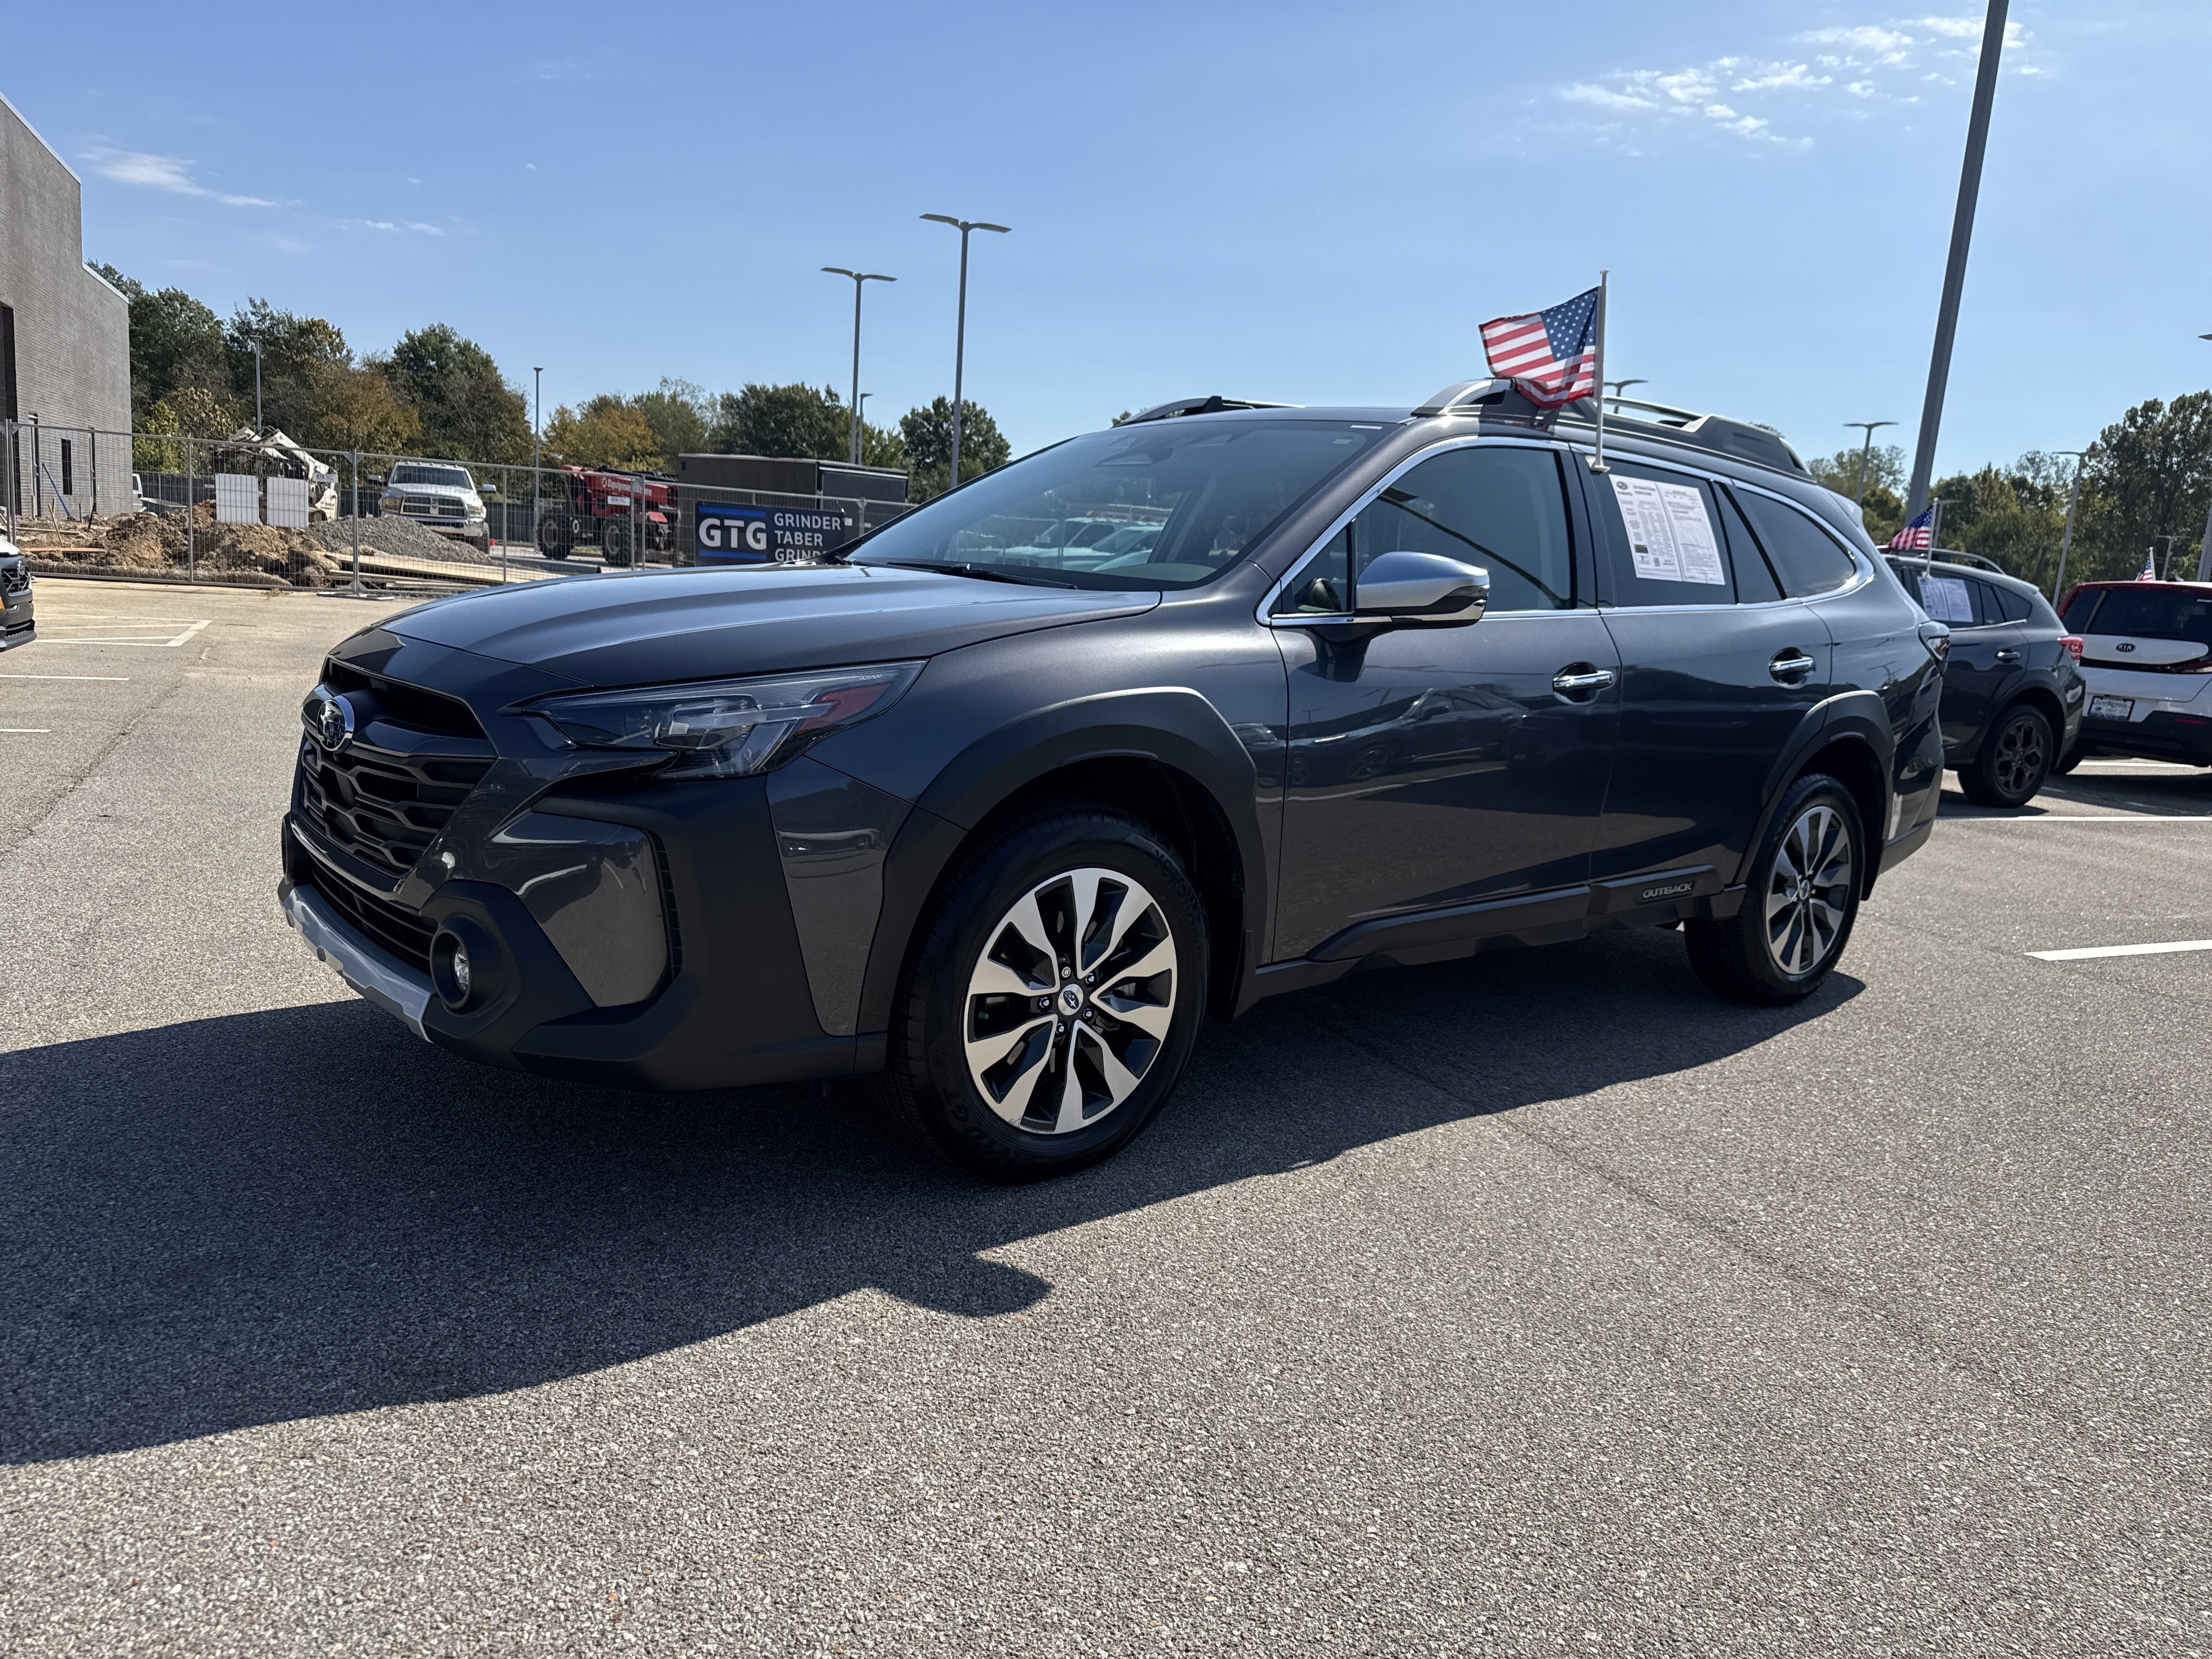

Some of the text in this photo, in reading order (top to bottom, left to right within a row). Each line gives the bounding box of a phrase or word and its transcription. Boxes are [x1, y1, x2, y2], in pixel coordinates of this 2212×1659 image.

[774, 512, 841, 531] GRINDER
[699, 518, 767, 550] GTG
[774, 531, 823, 547] TABER
[775, 549, 827, 561] GRIND
[1643, 882, 1692, 898] OUTBACK
